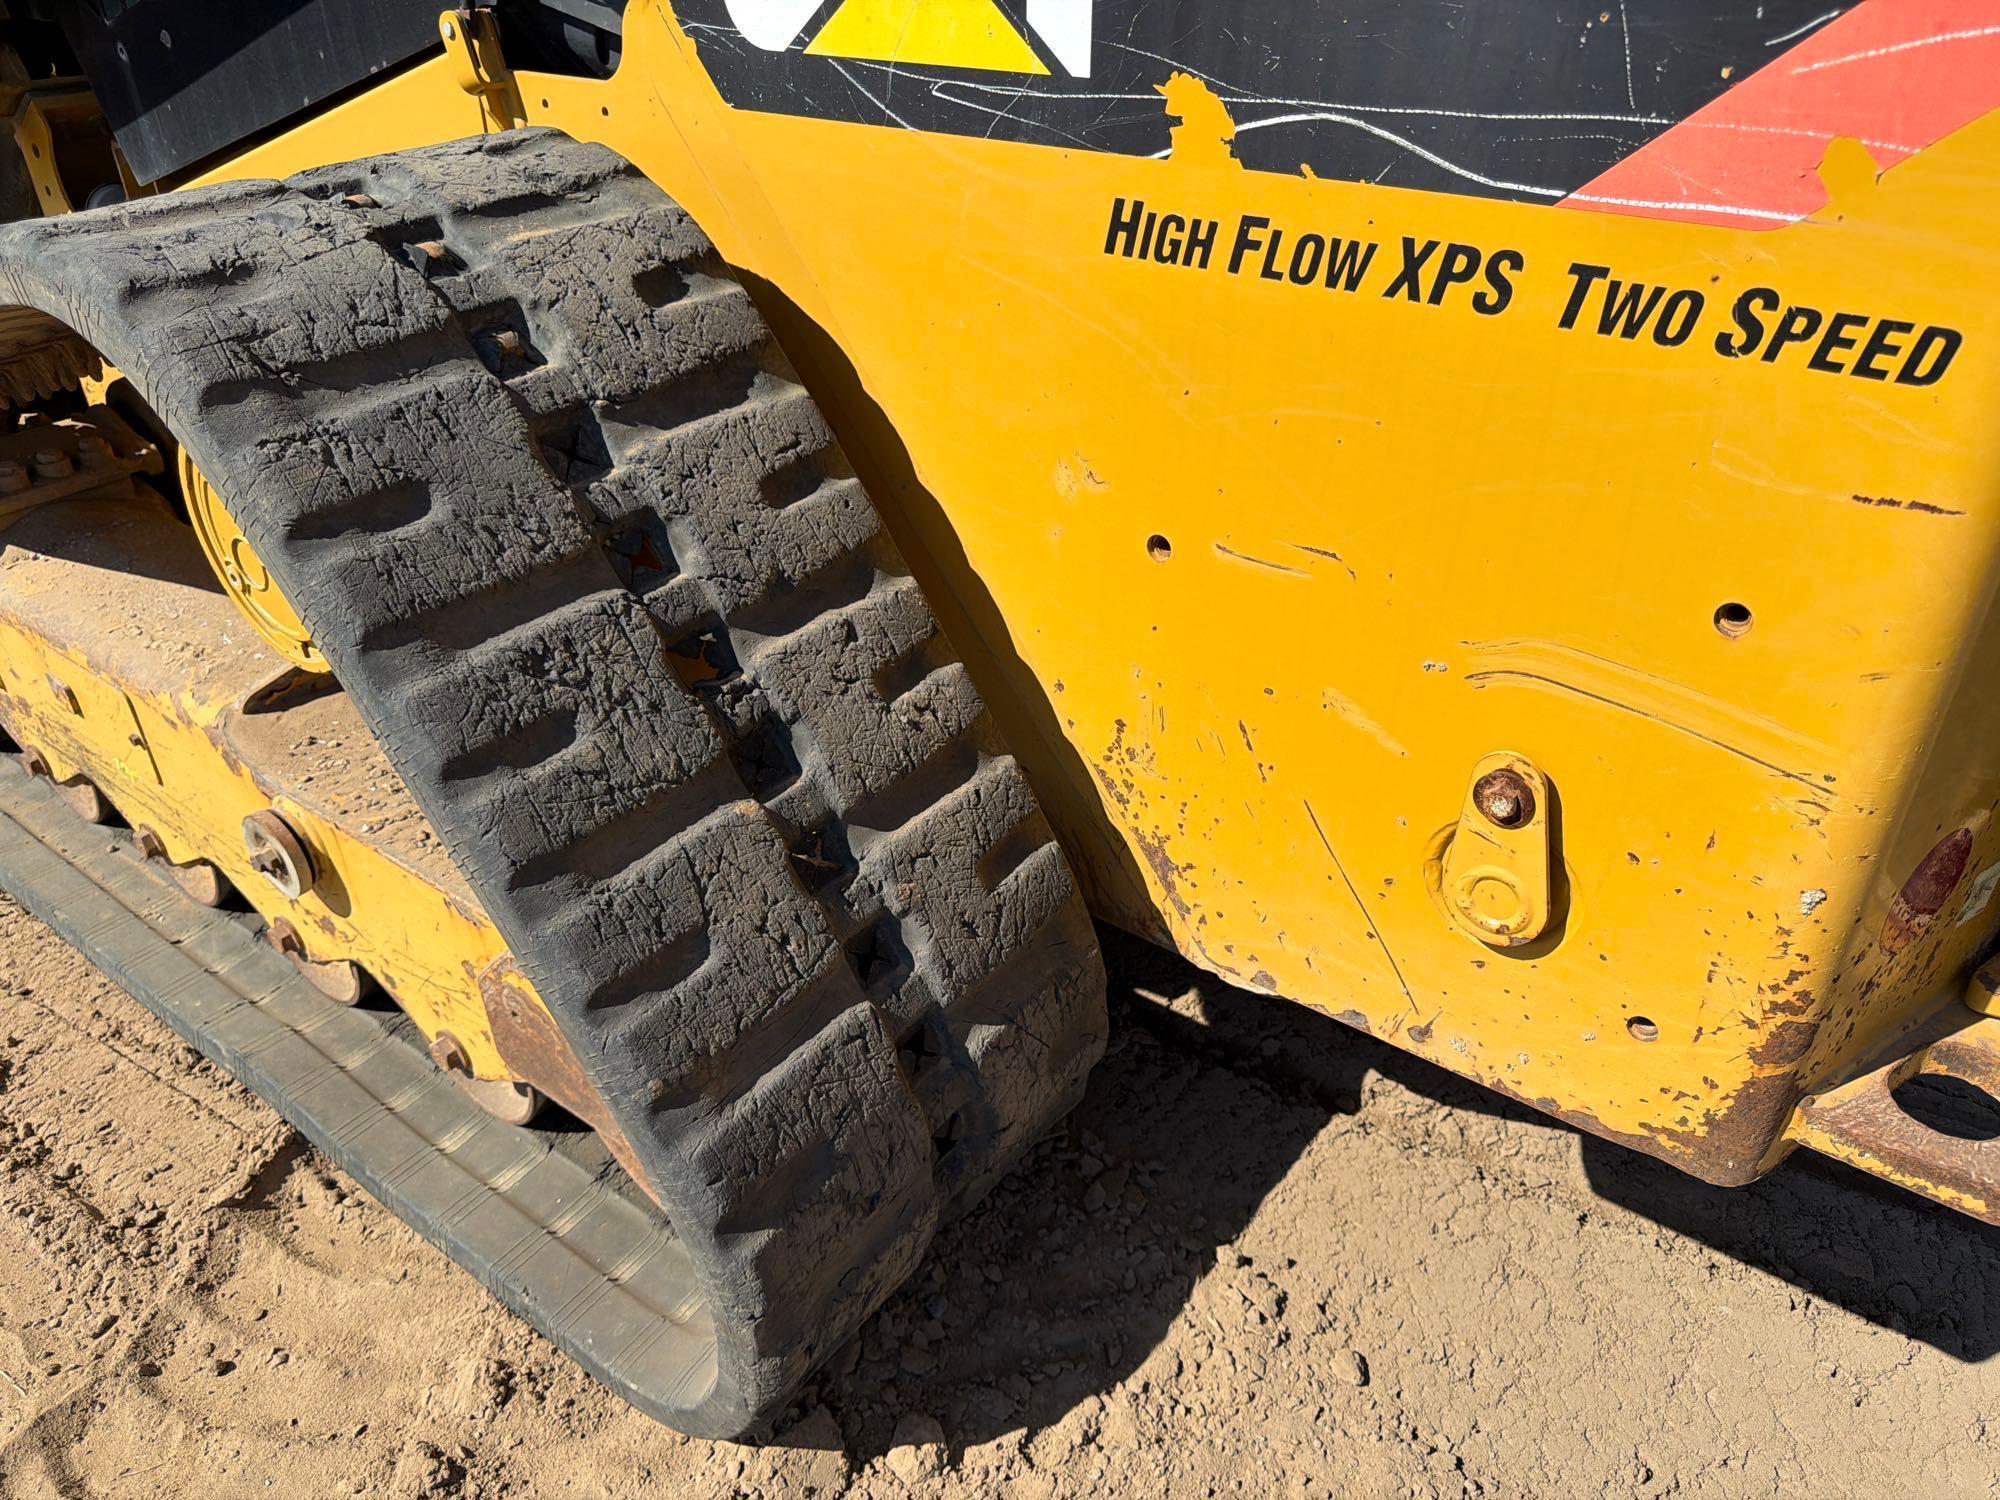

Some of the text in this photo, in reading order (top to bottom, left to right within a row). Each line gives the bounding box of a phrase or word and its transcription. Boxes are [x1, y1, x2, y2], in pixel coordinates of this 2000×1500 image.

[1103, 197, 1963, 387] HIGH FLOW XPS TWO SPEED
